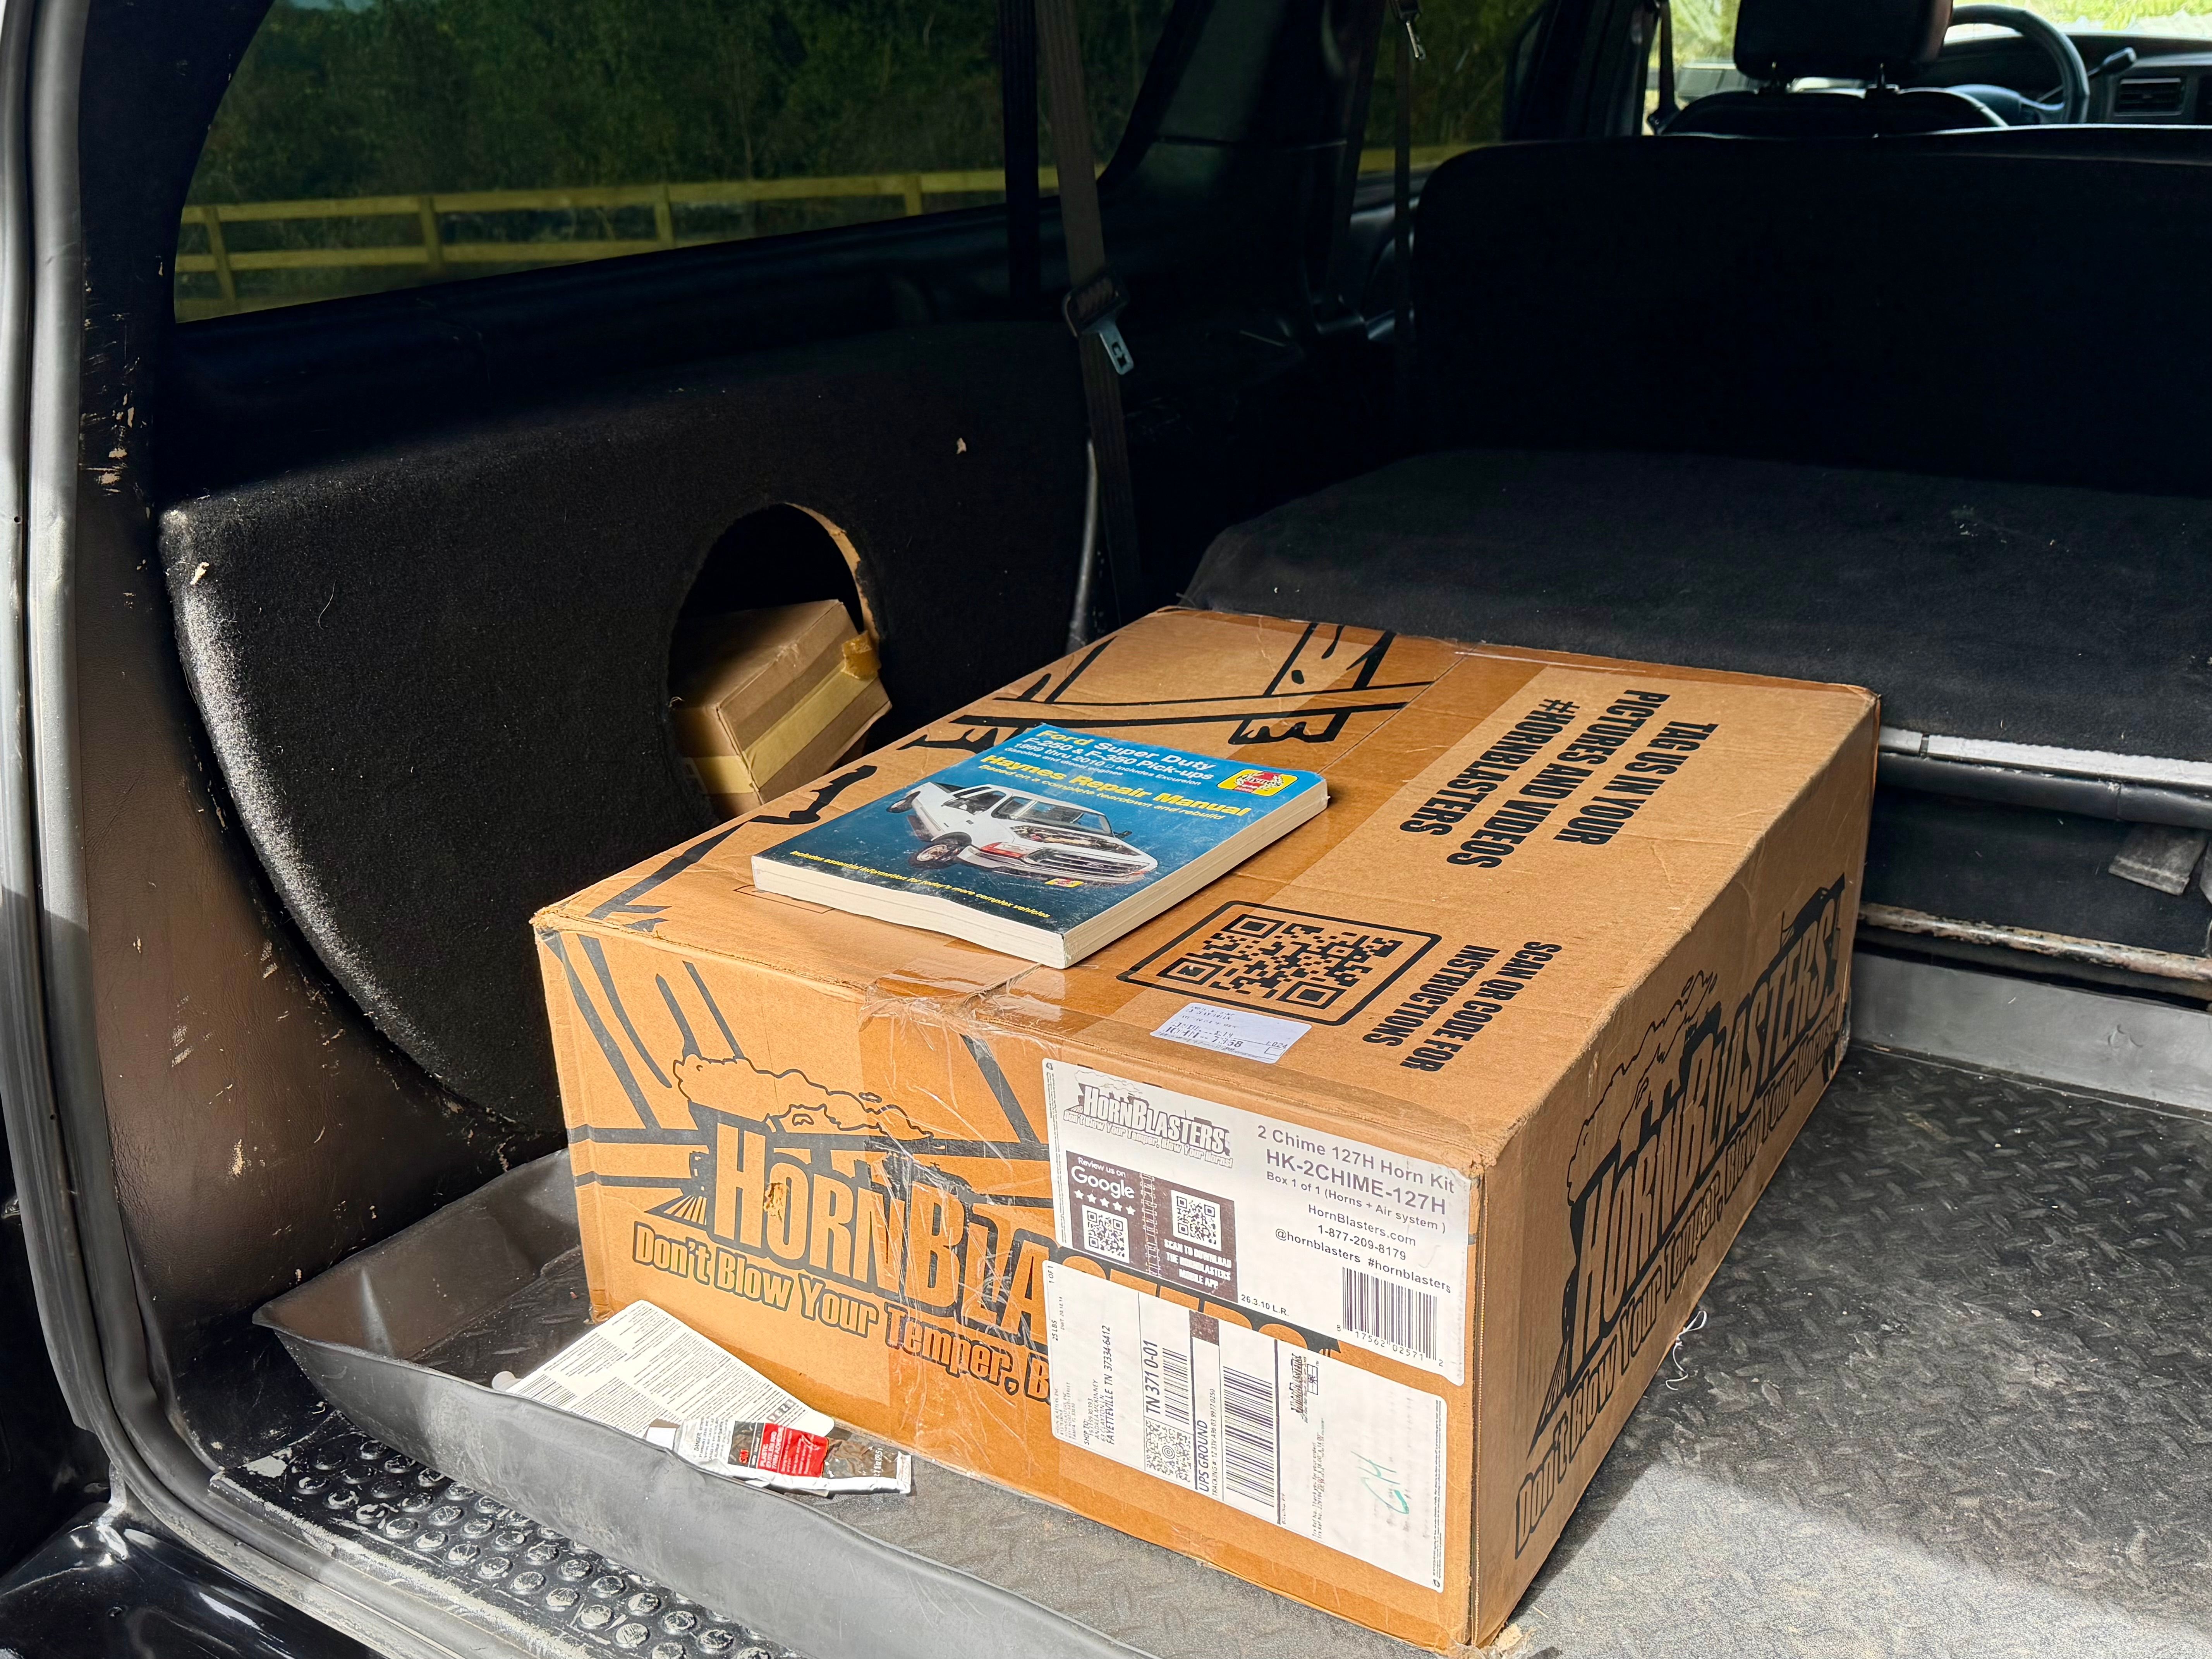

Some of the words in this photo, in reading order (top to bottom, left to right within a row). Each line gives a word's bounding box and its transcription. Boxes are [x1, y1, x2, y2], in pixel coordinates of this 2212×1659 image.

[1558, 689, 1671, 765] PICTURES
[1650, 720, 1719, 752] TAG
[1005, 747, 1042, 757] Gasoline
[1060, 759, 1088, 769] diesel
[1089, 766, 1124, 776] engines
[1015, 743, 1044, 752] 1999
[1044, 749, 1072, 759] thru
[1072, 756, 1105, 766] 2010
[1116, 765, 1154, 776] Includes
[1155, 773, 1202, 786] Excursion
[1023, 738, 1073, 750] F-250
[1084, 749, 1137, 765] F-350
[1136, 760, 1214, 780] Pick-ups
[1036, 730, 1094, 746] Ford
[1094, 742, 1160, 759] Super
[1161, 754, 1216, 770] Duty
[1400, 699, 1581, 836] #HORNBLASTERS
[1625, 752, 1690, 775] US
[978, 764, 1017, 775] Based
[1041, 780, 1095, 795] complete
[1096, 792, 1153, 808] teardown
[1178, 808, 1226, 820] rebuild
[981, 755, 1067, 780] Haynes
[1069, 775, 1153, 798] Repair
[1153, 792, 1252, 816] Manual
[1519, 763, 1594, 799] AND
[1603, 775, 1666, 796] IN
[1446, 800, 1559, 869] VIDEOS
[1553, 796, 1647, 845] YOUR
[790, 850, 825, 862] Includes
[824, 859, 863, 870] essential
[860, 866, 908, 881] information
[921, 880, 952, 890] today's
[951, 887, 975, 895] more
[975, 893, 1014, 907] complex
[1013, 904, 1051, 918] vehicles
[1496, 941, 1562, 979] SCAN
[1362, 945, 1501, 1046] INSTRUCTIONS
[1474, 979, 1525, 1001] QR
[1432, 1000, 1503, 1041] CODE
[1400, 1039, 1464, 1072] FOR
[1063, 1110, 1084, 1126] Don't
[1106, 1121, 1126, 1137] Your
[1127, 1127, 1160, 1149] Temper,
[1183, 1144, 1204, 1159] Your
[1078, 1156, 1105, 1172] Review
[1105, 1166, 1115, 1175] us
[1116, 1170, 1126, 1178] on
[1257, 1125, 1267, 1139] 2
[1272, 1129, 1326, 1156] Chime
[1332, 1146, 1374, 1170] 127H
[1380, 1159, 1424, 1184] Horn
[1430, 1173, 1455, 1194] Kit
[1071, 1165, 1135, 1199] Google
[1267, 1149, 1446, 1215] HK-2CHIME-127H
[1267, 1171, 1288, 1185] Box
[1292, 1179, 1297, 1188] 1
[1301, 1183, 1312, 1192] of
[1315, 1186, 1320, 1195] 1
[1324, 1188, 1363, 1208] (Horns
[1375, 1204, 1392, 1217] Air
[1395, 1211, 1438, 1230] system
[1441, 1222, 1446, 1234] )
[1309, 1204, 1417, 1247] HornBlasters.com
[1318, 1224, 1407, 1261] 1-877-209-8179
[1048, 1270, 1054, 1279] OF
[1275, 1228, 1361, 1263] @hornblasters
[1368, 1257, 1452, 1294] #hornblasters
[633, 1221, 712, 1285] Don't
[714, 1247, 795, 1311] Blow
[799, 1272, 879, 1338] Your
[884, 1301, 1020, 1395] Temper,
[1241, 1294, 1271, 1310] 26.3.10
[1052, 1332, 1058, 1341] 25
[1102, 1325, 1112, 1372] 37334-6412
[1143, 1340, 1159, 1369] 0-01
[1355, 1331, 1386, 1348] 17562
[1392, 1344, 1424, 1361] 02571
[1438, 1359, 1444, 1367] 2
[1104, 1374, 1113, 1386] TN
[1144, 1370, 1160, 1394] 371
[1515, 1410, 1568, 1560] Don't
[1569, 1333, 1619, 1463] Blow
[1620, 1265, 1662, 1376] Your
[1664, 1171, 1723, 1304] Temper,
[1099, 1395, 1105, 1403] LN
[1104, 1388, 1115, 1445] FAYETTEVILLE
[1145, 1395, 1161, 1414] TN
[1100, 1433, 1106, 1442] 63
[1210, 1419, 1216, 1427] 03
[739, 1449, 749, 1464] 3M
[759, 1443, 769, 1467] PLASTIC
[1197, 1420, 1209, 1467] GROUND
[1197, 1470, 1210, 1492] UPS
